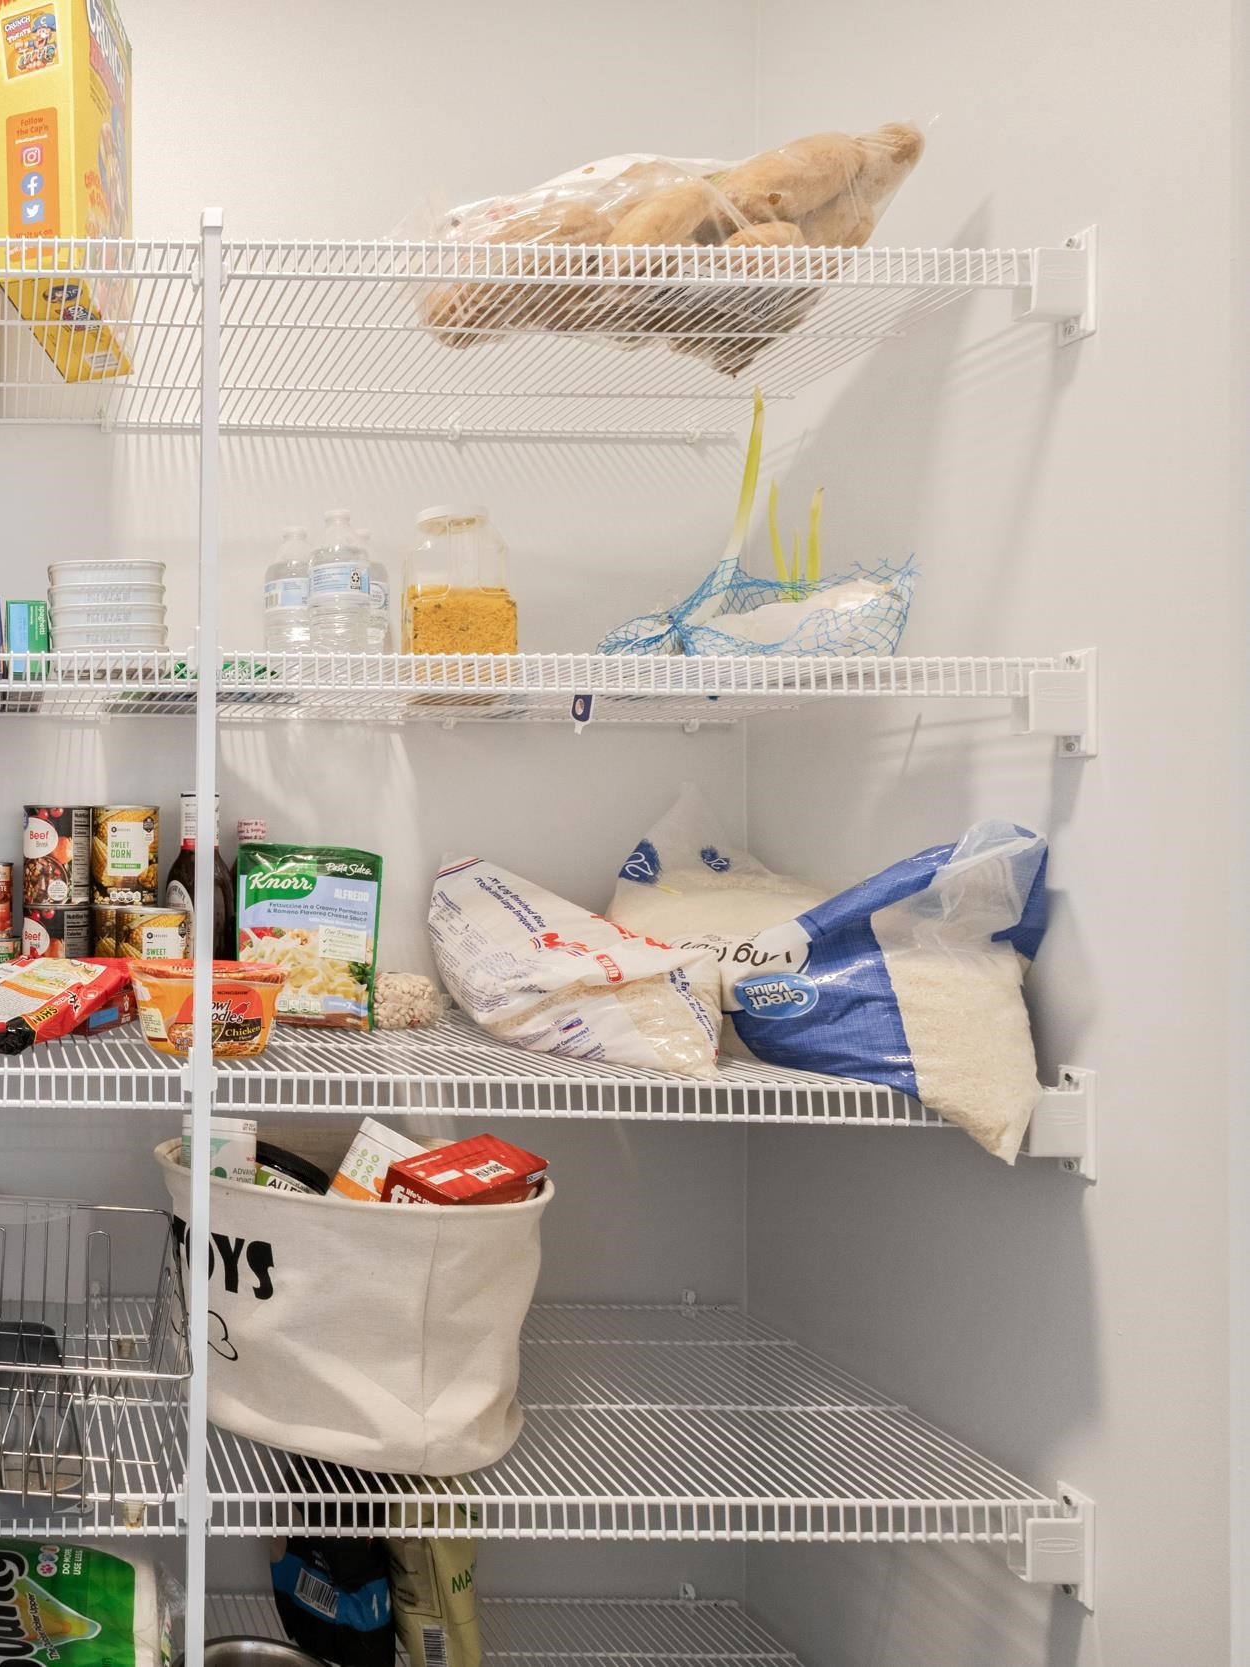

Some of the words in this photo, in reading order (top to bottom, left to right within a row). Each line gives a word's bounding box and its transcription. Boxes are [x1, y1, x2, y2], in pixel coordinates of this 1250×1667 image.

[21, 117, 44, 126] Follow
[16, 128, 29, 136] the
[38, 605, 46, 635] spaghetti
[29, 831, 49, 839] Beef
[110, 849, 132, 858] CORN
[326, 862, 348, 872] Pasta
[346, 863, 372, 876] Sides
[249, 872, 312, 890] Knorr
[334, 888, 370, 901] ALFREDO
[269, 901, 301, 909] Fettuccine
[315, 903, 338, 912] Creamy
[338, 906, 368, 916] Parmesan
[273, 908, 299, 916] Romano
[300, 909, 327, 917] Flavored
[327, 911, 349, 919] Cheese
[349, 914, 368, 922] Sauce
[24, 931, 41, 939] Beef
[744, 980, 789, 996] Value
[211, 998, 232, 1011] owl
[749, 988, 809, 1010] Great
[32, 1005, 58, 1024] SHIN
[211, 1010, 244, 1023] odles
[224, 1024, 261, 1037] Chicken
[62, 1565, 70, 1575] DO
[73, 1562, 81, 1575] USE
[26, 1592, 38, 1614] Upper
